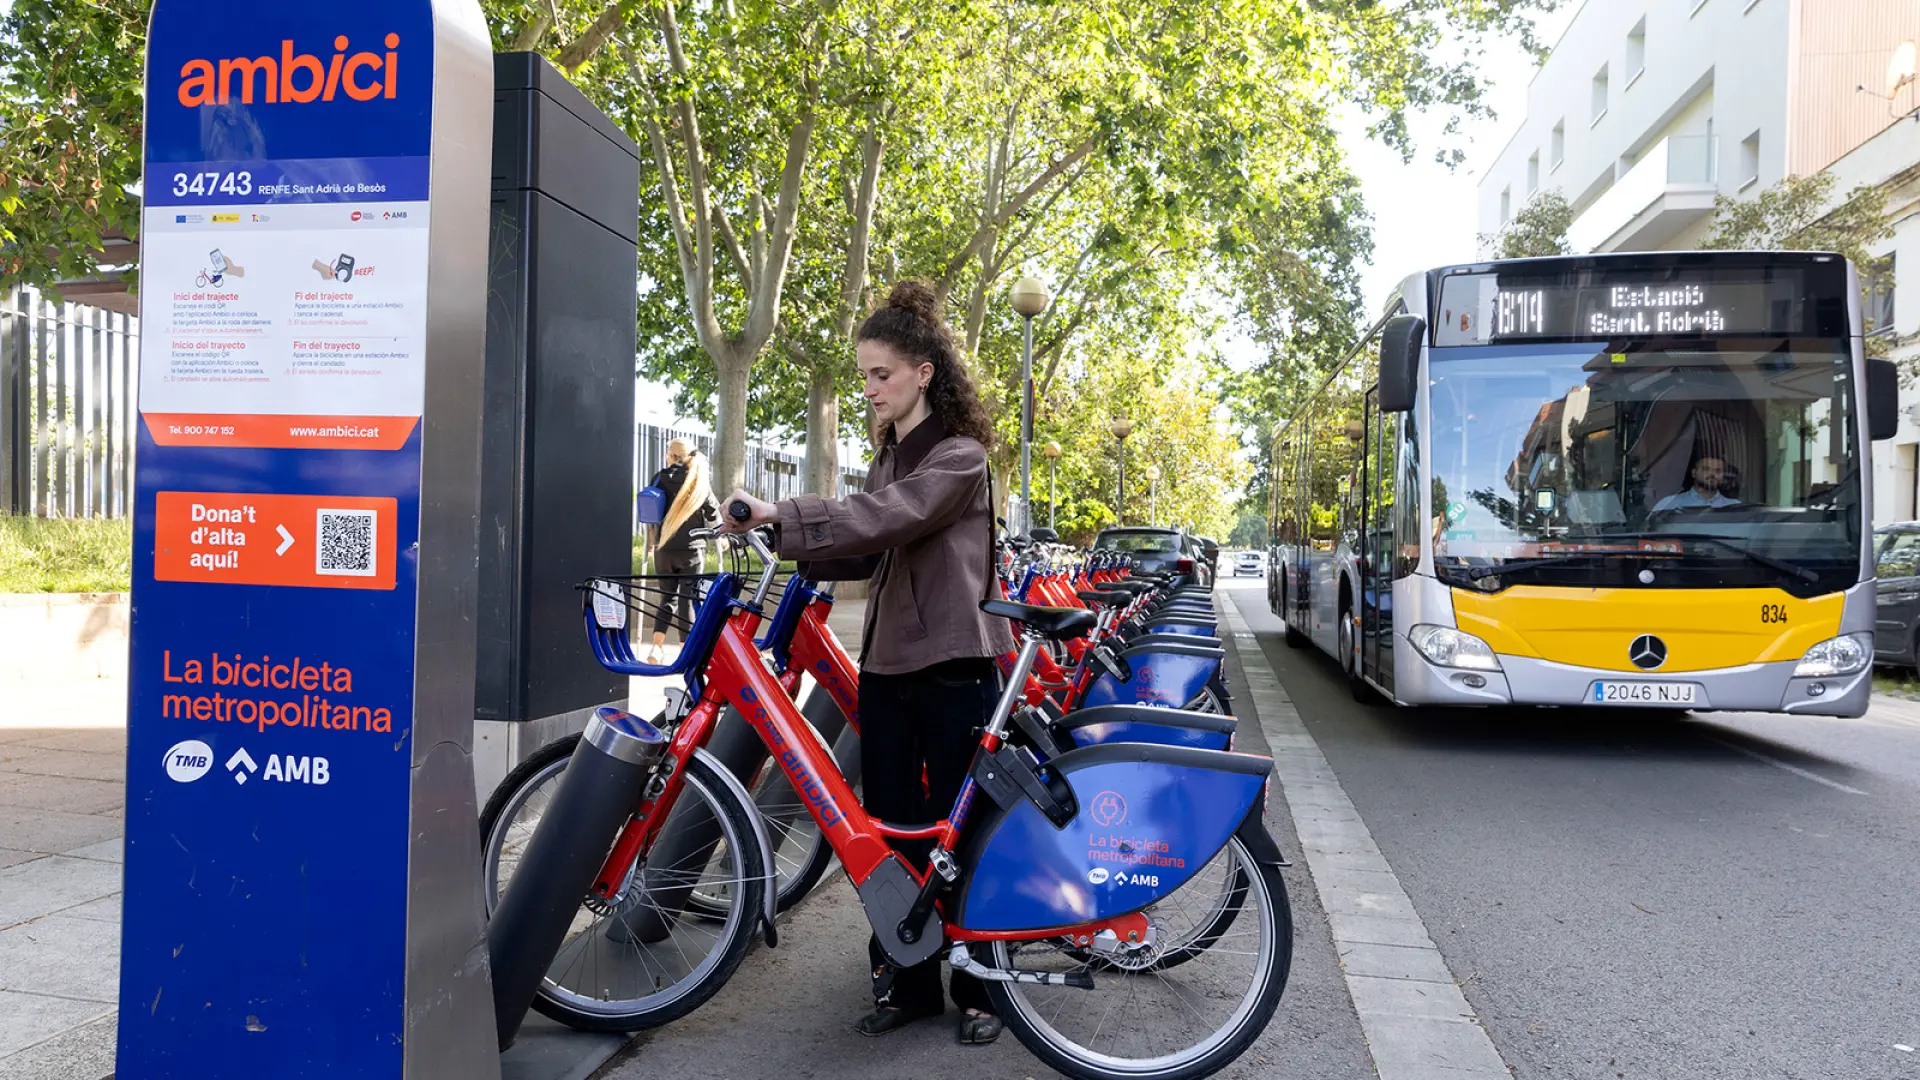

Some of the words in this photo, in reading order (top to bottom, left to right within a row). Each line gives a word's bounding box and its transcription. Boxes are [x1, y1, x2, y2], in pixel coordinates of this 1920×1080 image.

[178, 32, 399, 108] ambici
[172, 171, 252, 197] 34743
[258, 184, 290, 195] RENFE
[292, 184, 314, 194] Sant
[316, 183, 341, 193] Adrià
[343, 183, 356, 193] de
[357, 182, 386, 193] Besòs
[391, 211, 408, 219] AMB
[173, 292, 190, 300] Inici
[192, 292, 205, 300] del
[207, 292, 239, 302] trajecte
[294, 292, 303, 300] Fi
[305, 292, 318, 300] del
[320, 292, 354, 301] trajecte
[1611, 285, 1704, 307] Estació
[1499, 290, 1543, 333] B14
[1590, 311, 1650, 333] Sant
[1657, 310, 1724, 332] Adrià
[172, 341, 194, 349] Inicio
[196, 341, 209, 349] del
[210, 341, 246, 351] trayecto
[293, 341, 306, 350] Fin
[308, 341, 322, 350] del
[324, 341, 361, 351] trayecto
[169, 426, 182, 434] Tel.
[184, 426, 202, 435] 900
[204, 426, 218, 435] 747
[221, 427, 234, 435] 152
[290, 427, 379, 438] www.ambici.cat
[1448, 503, 1465, 519] SU
[190, 550, 239, 571] aquí!
[1761, 604, 1788, 624] 834
[164, 650, 203, 683] La
[212, 652, 352, 692] bicicleta
[1607, 684, 1652, 700] 2046
[1659, 685, 1692, 701] NJJ
[162, 691, 391, 733] metropolitana
[764, 720, 785, 745] AMB
[175, 755, 208, 768] TMB
[263, 753, 330, 785] AMB
[782, 748, 848, 828] ambici
[1089, 832, 1107, 847] La
[1087, 849, 1185, 869] metropolitana
[1130, 874, 1159, 887] AMB
